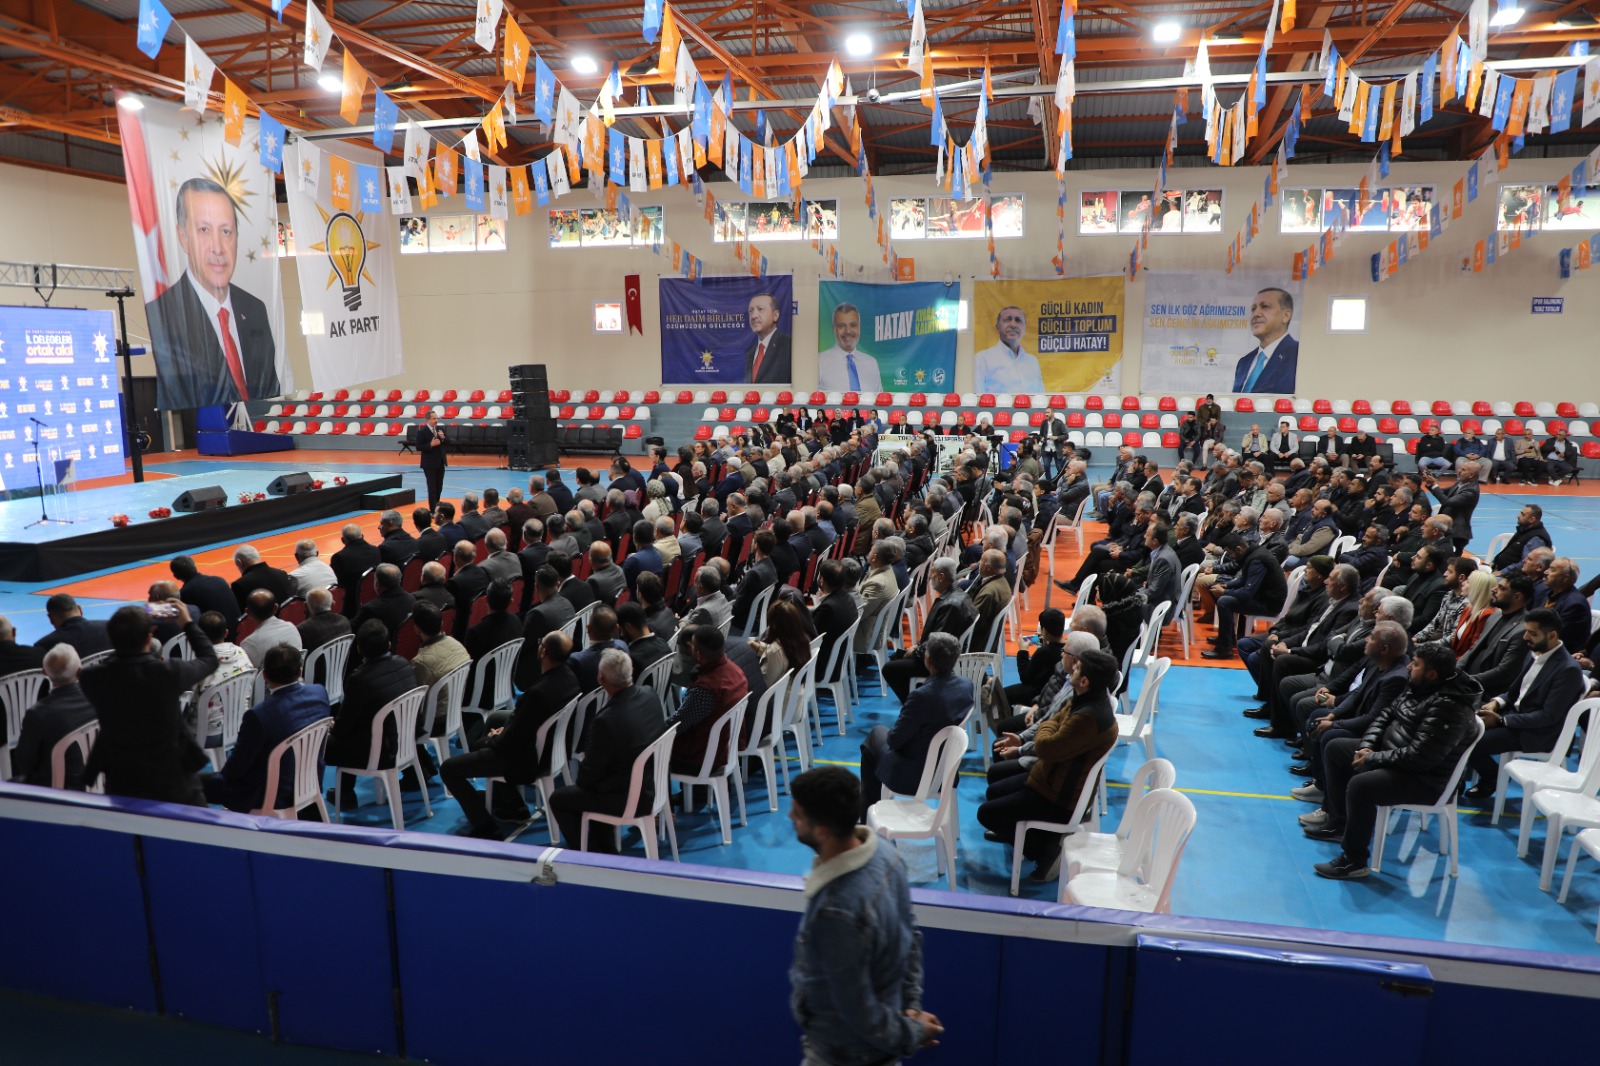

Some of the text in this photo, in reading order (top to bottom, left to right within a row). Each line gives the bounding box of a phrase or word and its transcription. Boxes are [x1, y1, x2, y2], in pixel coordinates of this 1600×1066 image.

[1041, 301, 1103, 317] GÜÇLÜ KADIN
[1151, 304, 1245, 316] SEN İLK GÖZ AĞRIMIZSIN
[666, 313, 745, 323] HER DAİM BİRLİKTE
[1150, 318, 1164, 328] SEN
[330, 320, 347, 338] AK
[875, 310, 914, 342] HATAY
[1041, 318, 1112, 335] GÜÇLÜ TOPLUM
[33, 335, 73, 345] DELEGELERİ
[1041, 336, 1107, 352] GÜÇLÜ HATAY!
[27, 344, 55, 356] ortak
